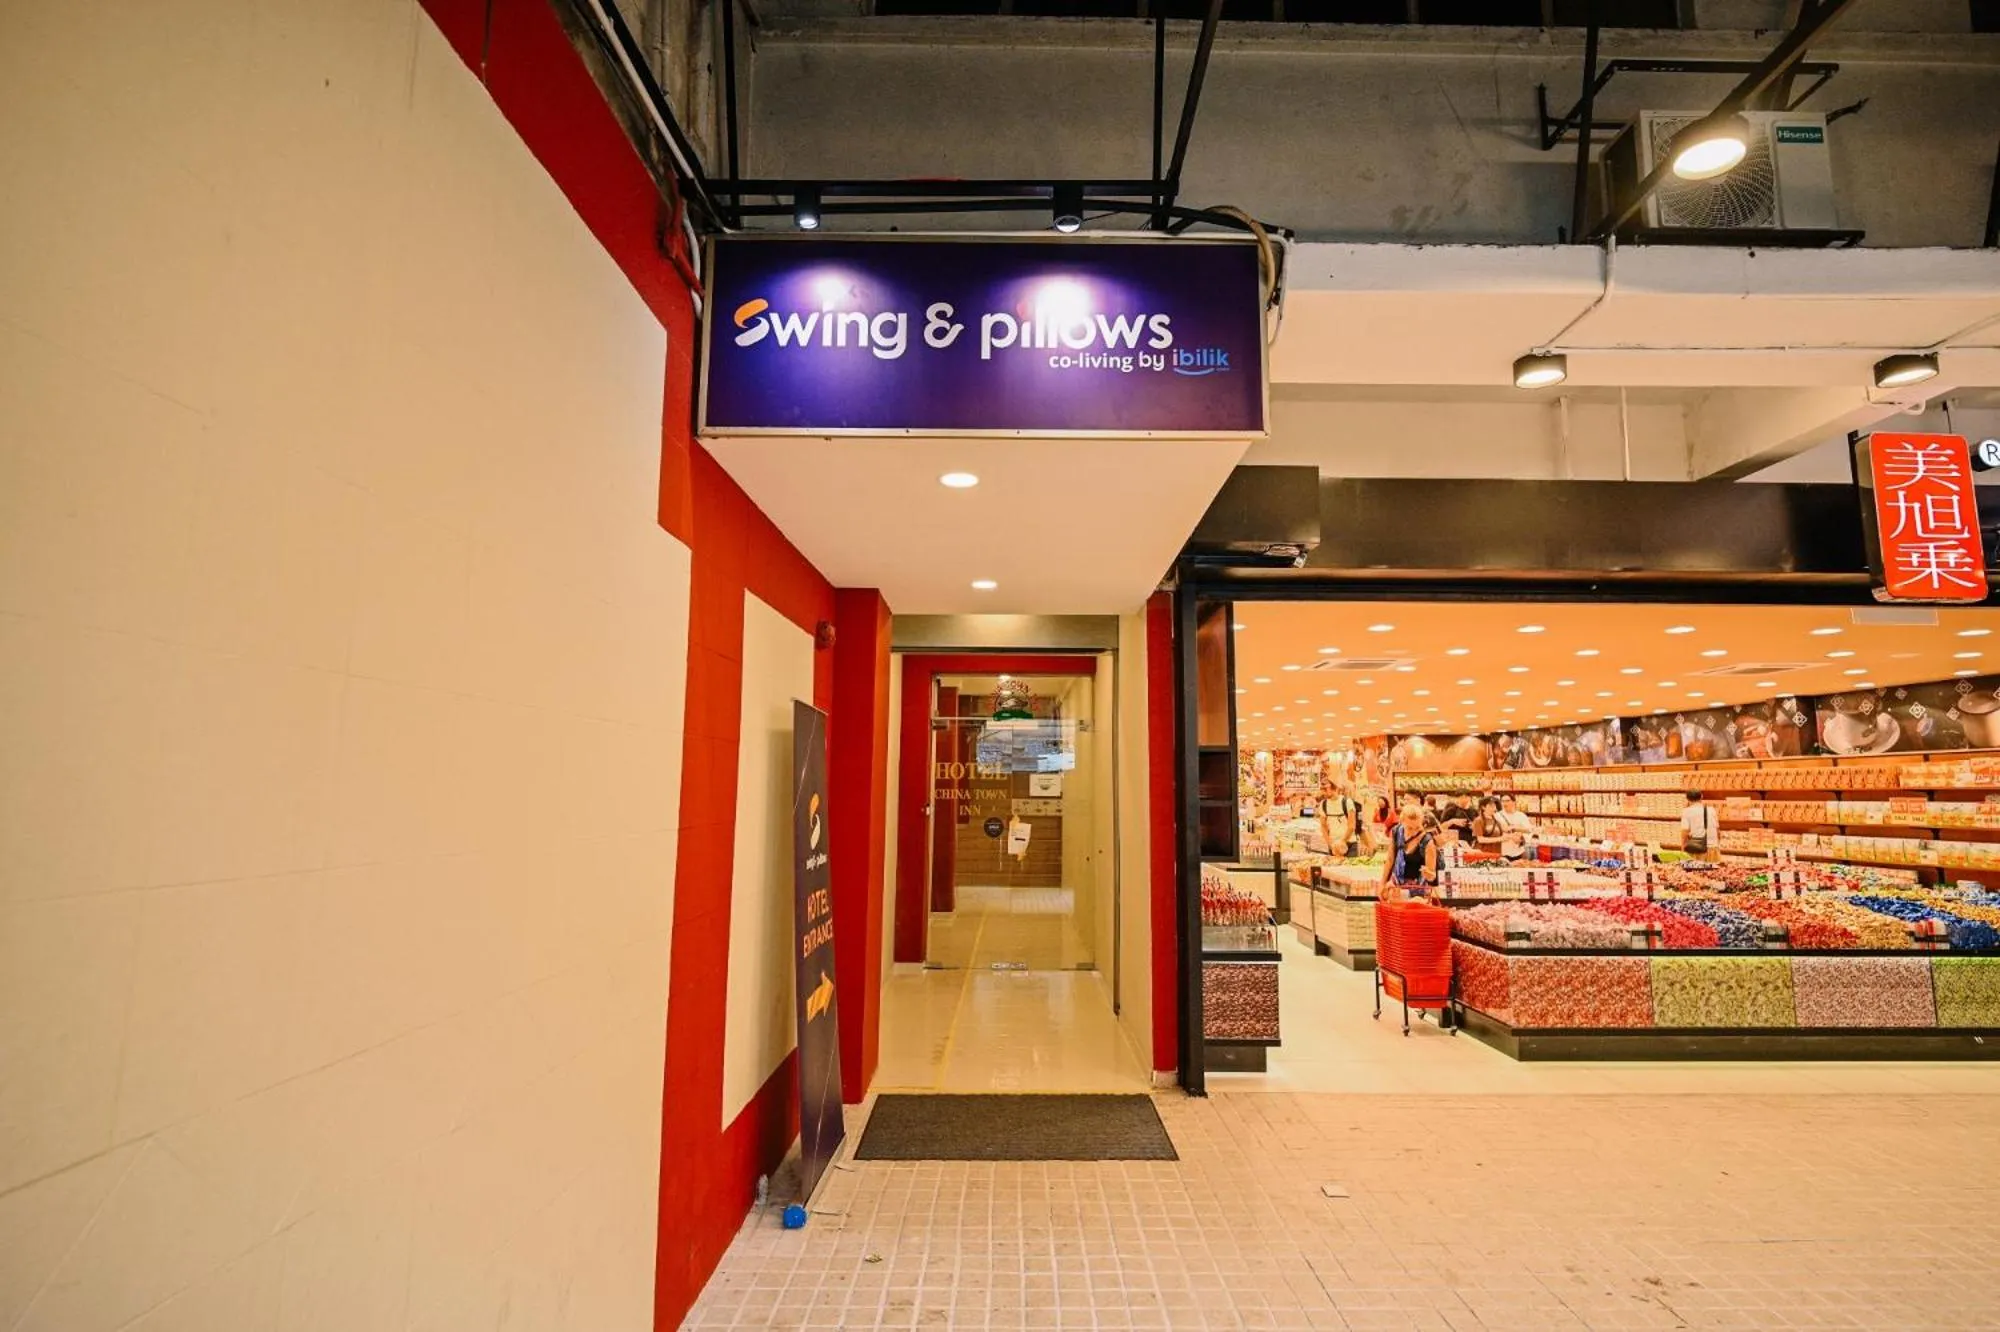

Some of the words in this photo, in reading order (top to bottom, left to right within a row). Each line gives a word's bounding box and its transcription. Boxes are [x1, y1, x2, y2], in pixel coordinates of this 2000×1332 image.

[1778, 129, 1822, 139] Hisense
[924, 302, 965, 348] &
[981, 294, 1173, 360] pillows
[1049, 352, 1134, 373] co-living
[1138, 350, 1165, 372] by
[1172, 349, 1229, 366] ibilik
[936, 762, 1008, 780] HOTEL
[935, 789, 971, 800] CHINA
[975, 789, 1007, 800] TOWN
[960, 805, 981, 816] INN
